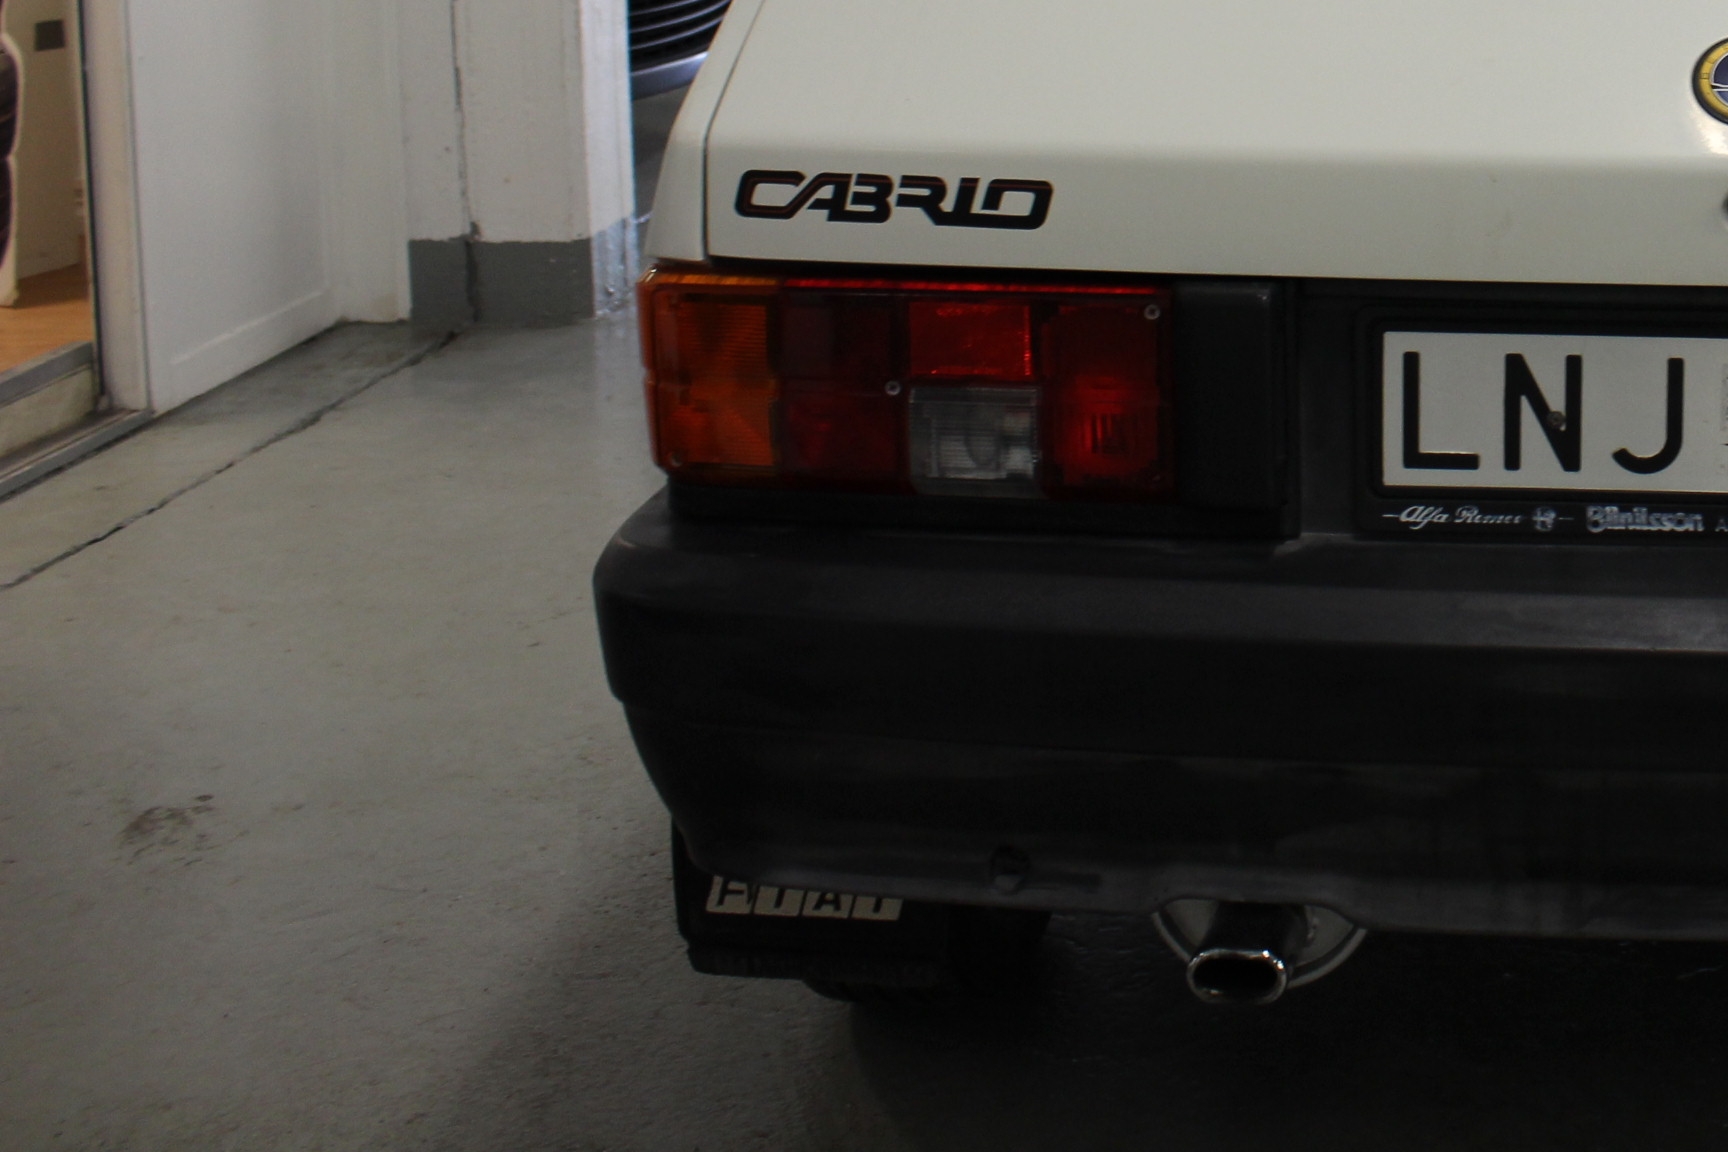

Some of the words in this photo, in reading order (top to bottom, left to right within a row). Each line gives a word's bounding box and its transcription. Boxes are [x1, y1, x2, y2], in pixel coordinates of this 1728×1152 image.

[734, 169, 1054, 230] CABRIO
[1402, 350, 1685, 474] LNJ
[1398, 505, 1450, 530] Alfa
